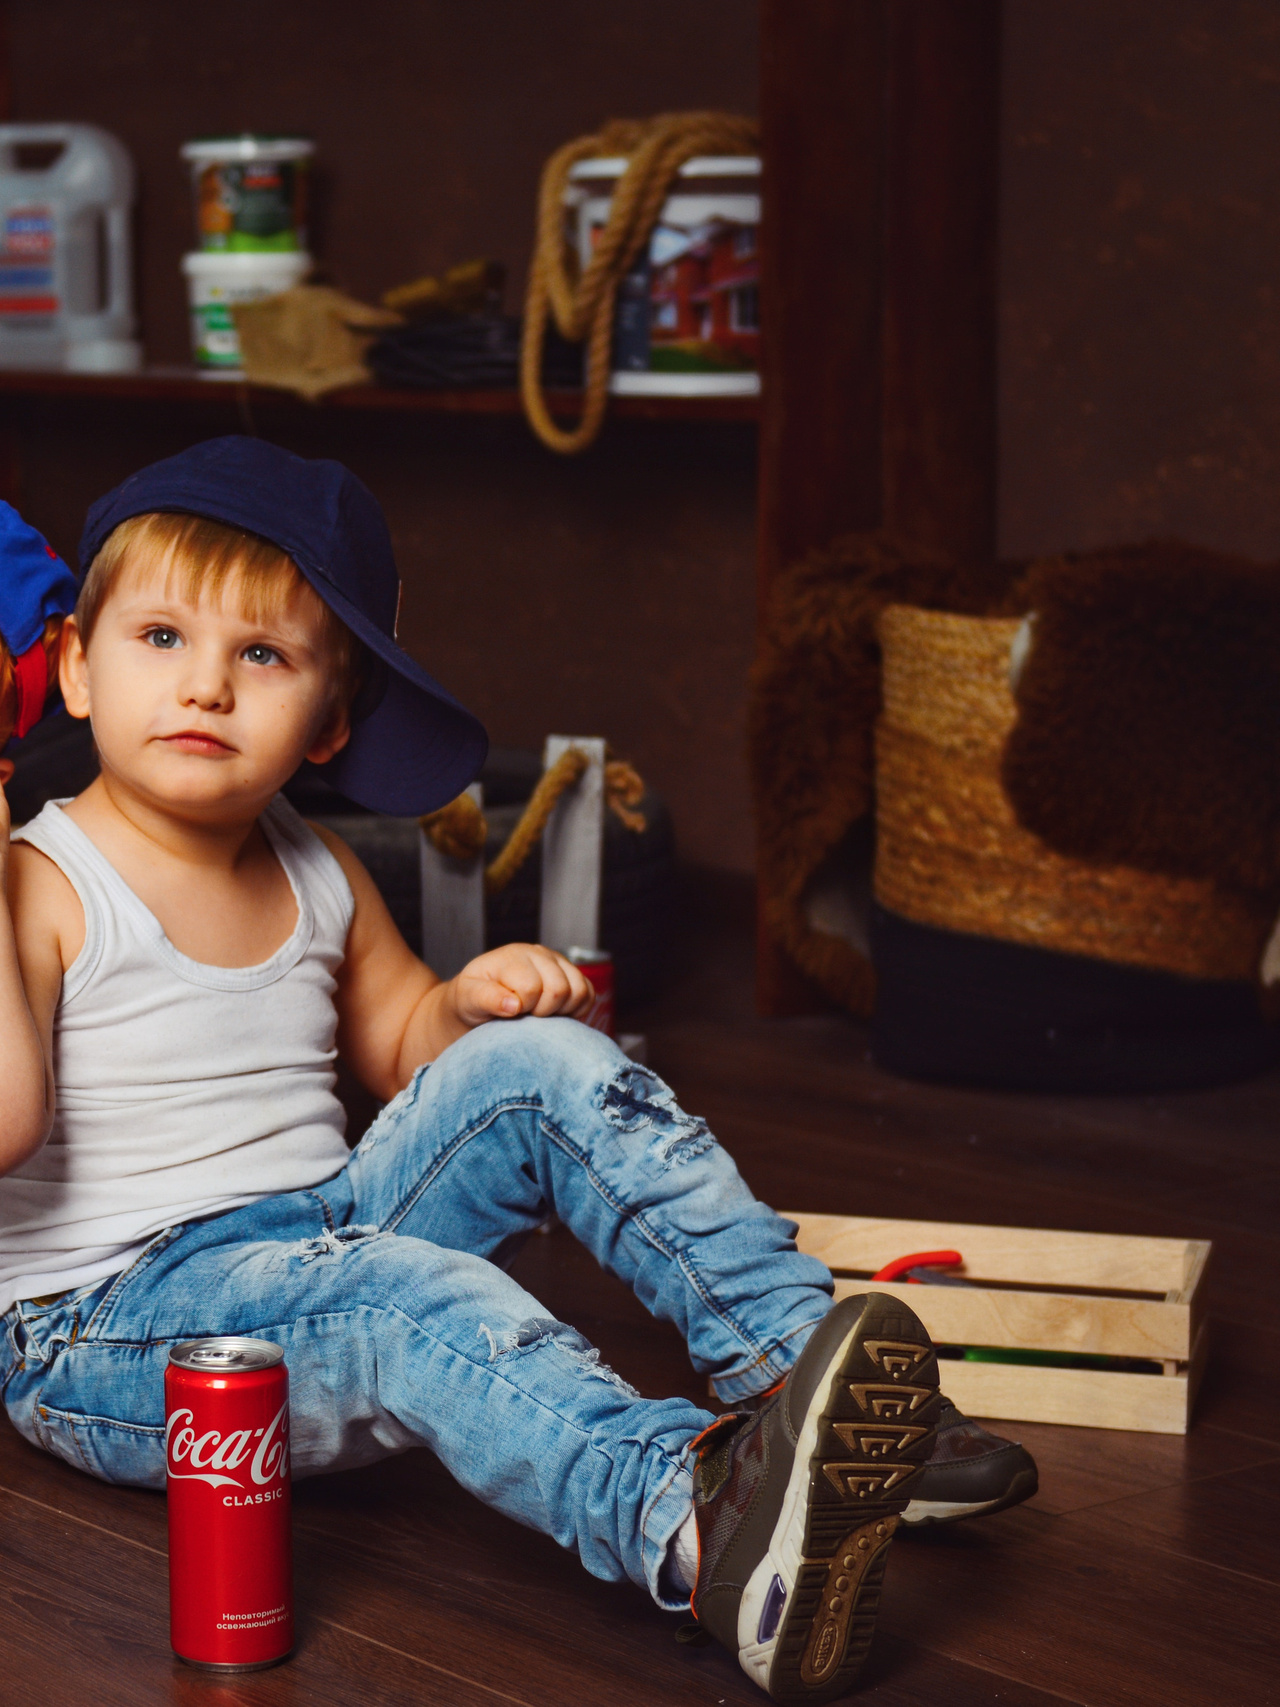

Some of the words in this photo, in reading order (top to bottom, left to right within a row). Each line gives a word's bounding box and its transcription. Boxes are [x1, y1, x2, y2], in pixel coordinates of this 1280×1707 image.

[222, 1487, 283, 1507] CLASSIC
[222, 1604, 285, 1621] Неповторимый
[216, 1616, 276, 1630] освежающий
